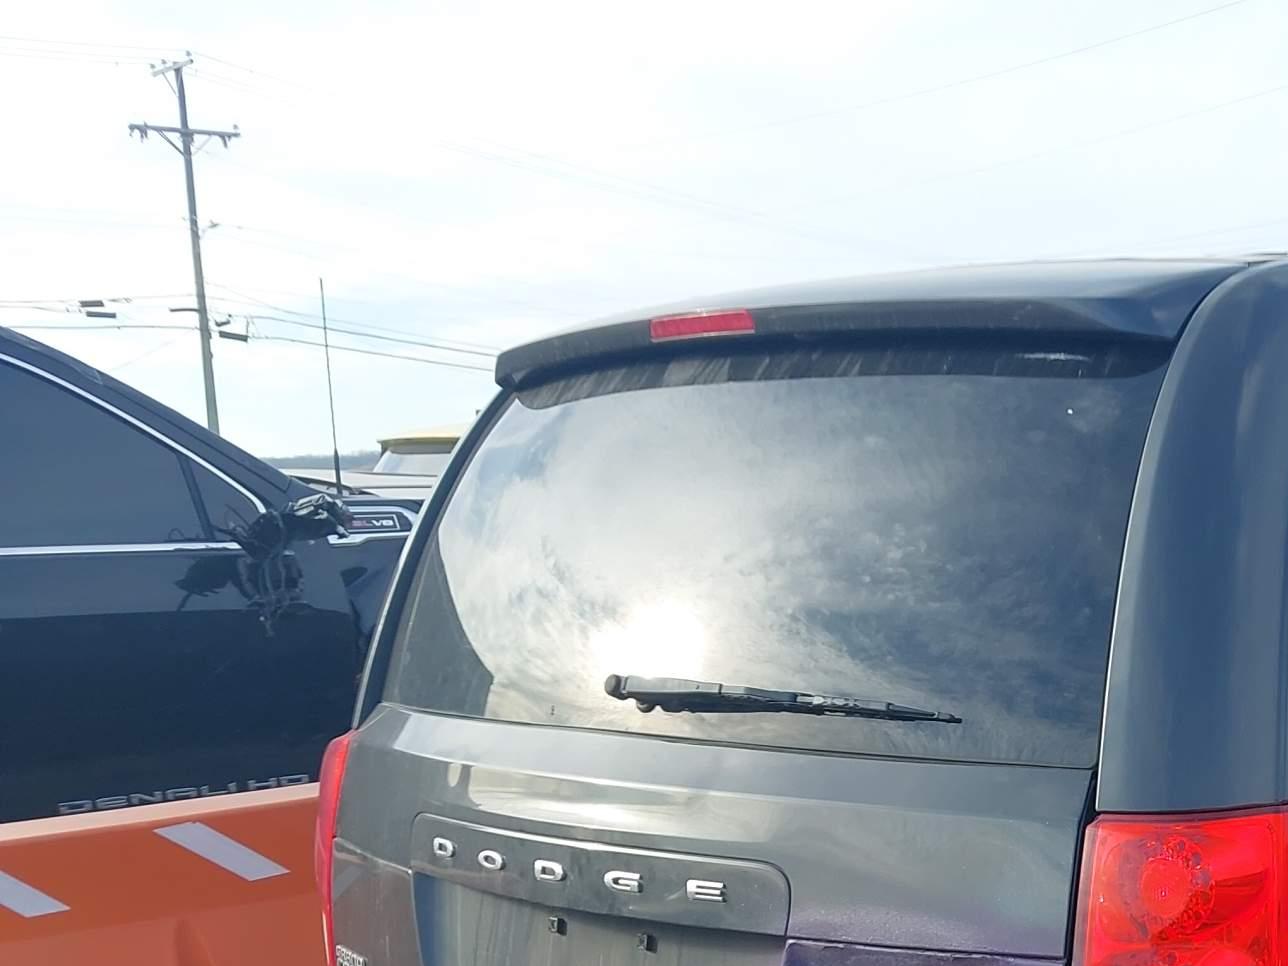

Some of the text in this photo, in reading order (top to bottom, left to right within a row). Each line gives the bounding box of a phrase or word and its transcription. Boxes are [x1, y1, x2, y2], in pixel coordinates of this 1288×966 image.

[58, 773, 309, 815] DENALI HD
[433, 836, 727, 902] DODGE
